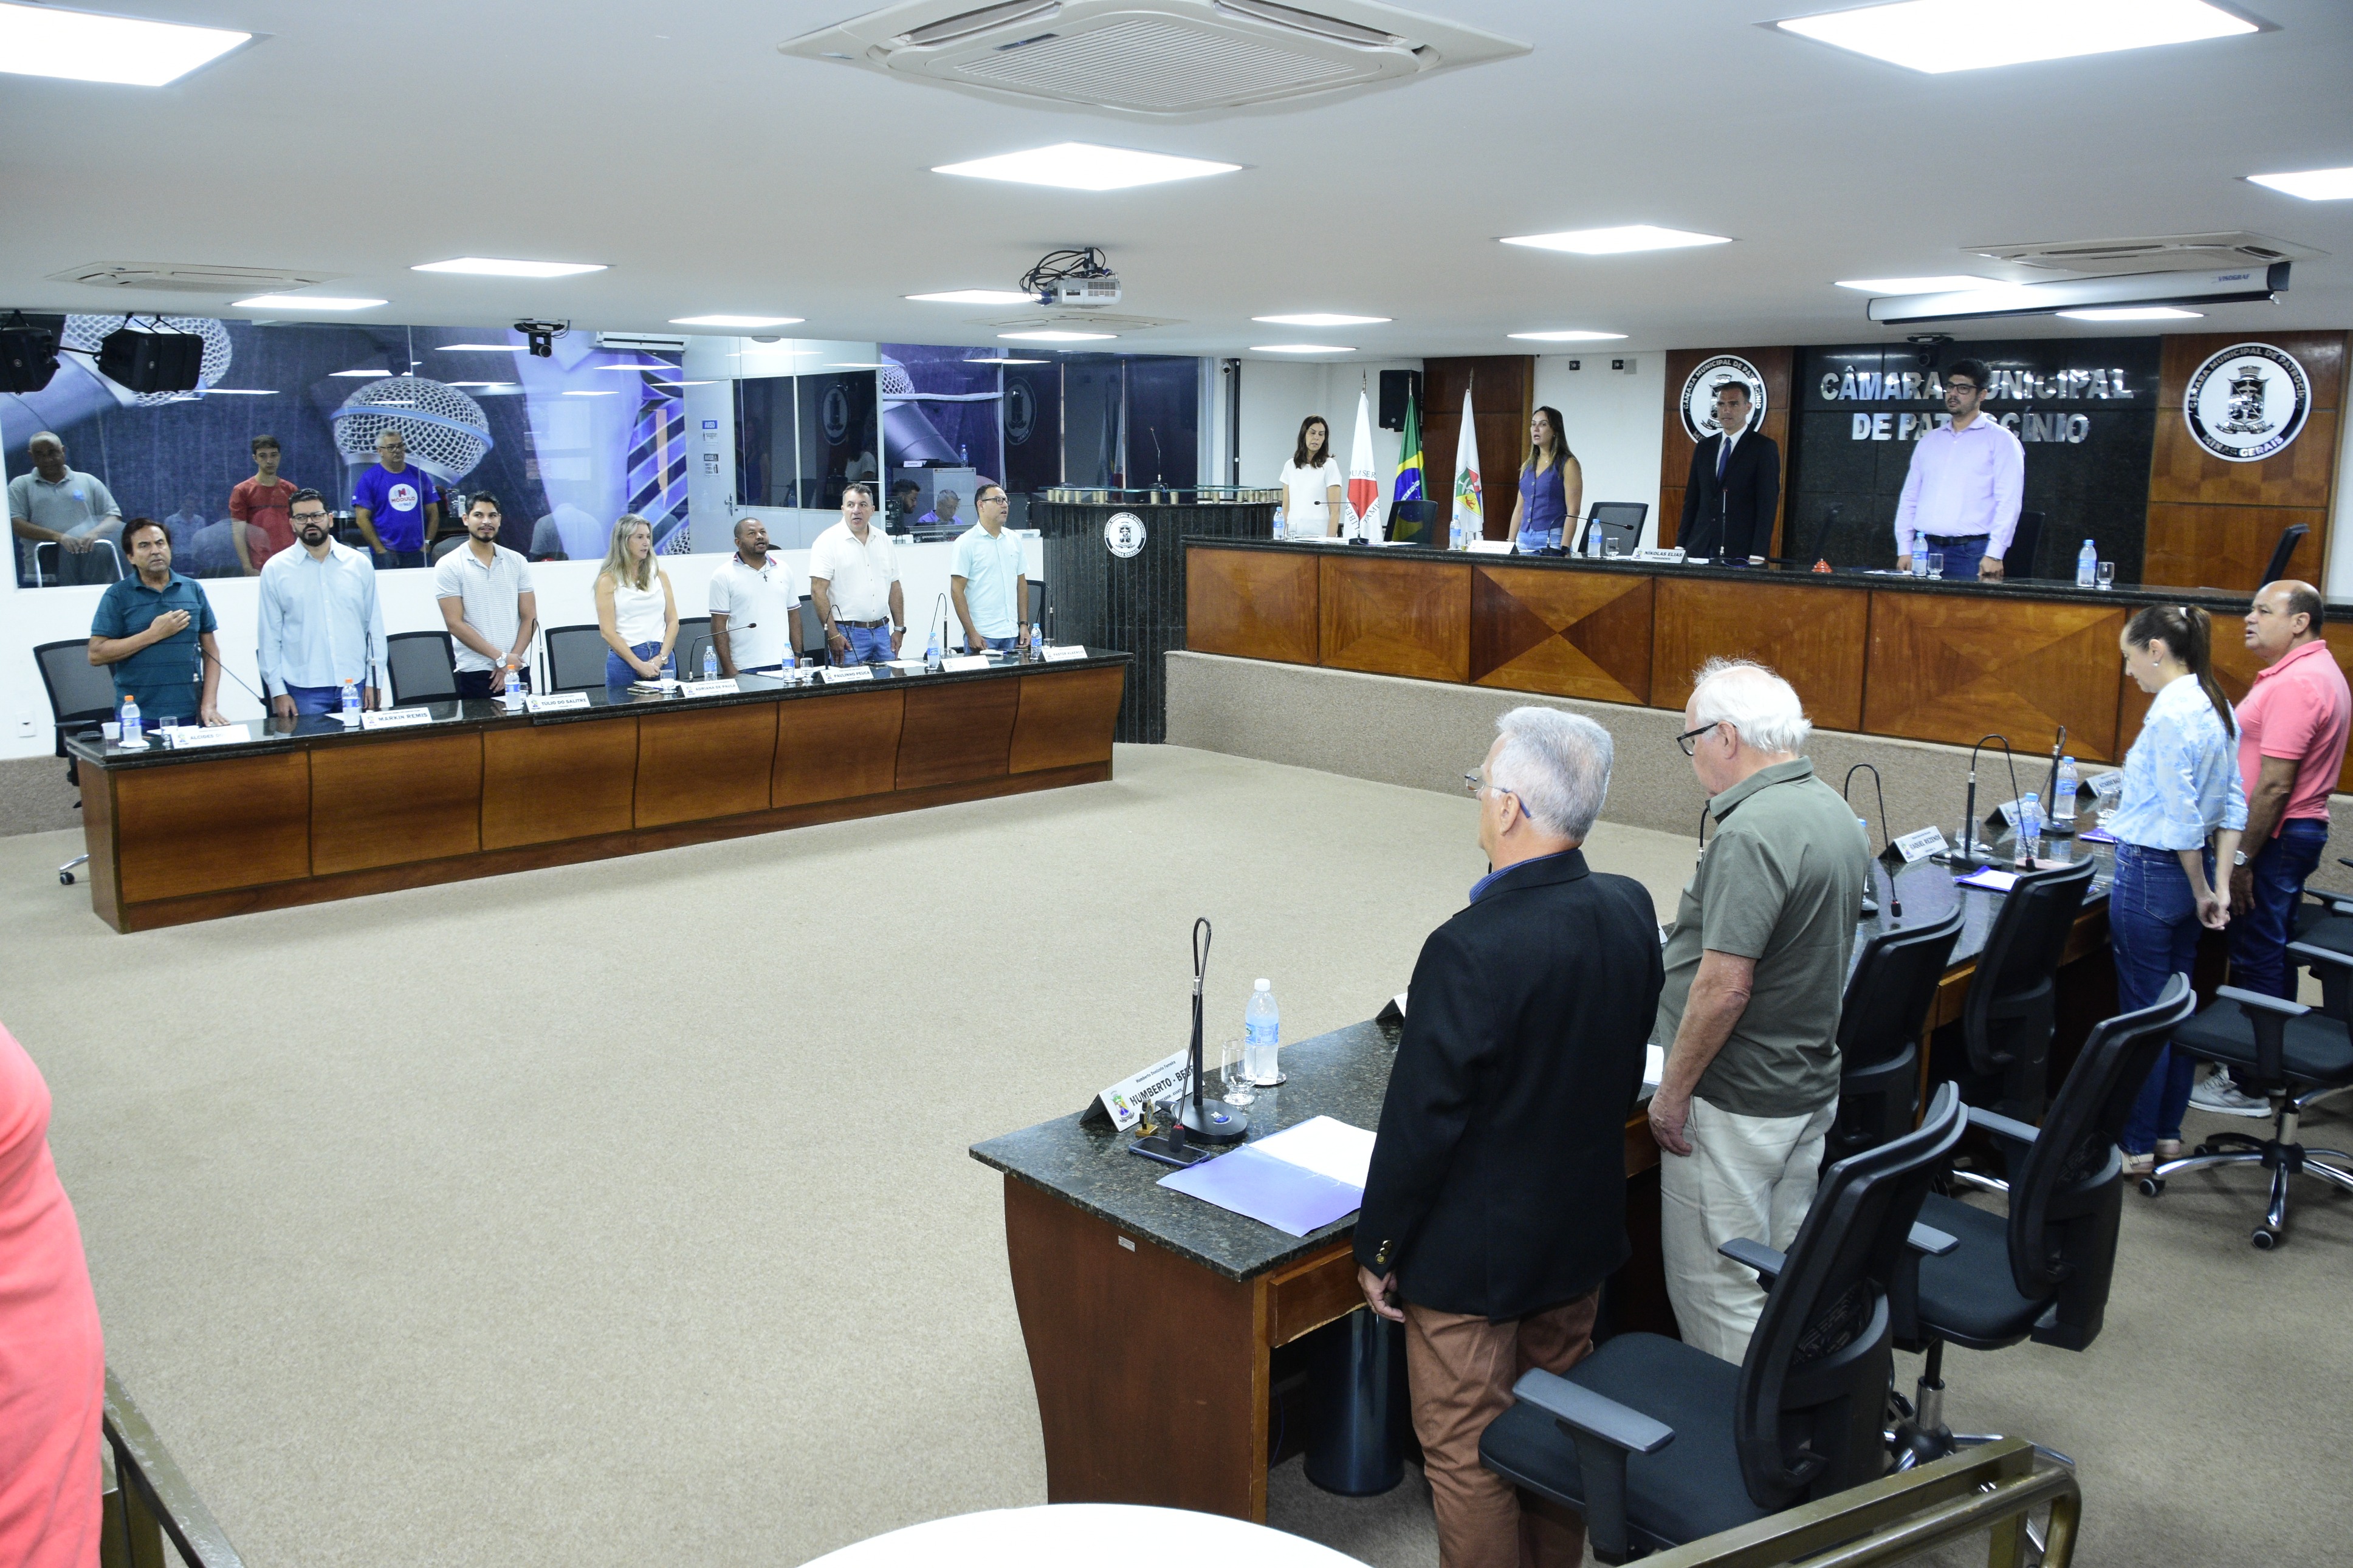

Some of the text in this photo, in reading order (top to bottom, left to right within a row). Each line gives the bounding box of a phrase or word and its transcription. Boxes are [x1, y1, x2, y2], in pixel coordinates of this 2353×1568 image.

[1695, 359, 1732, 378] MUNICIPAL
[1733, 361, 1743, 370] DE
[2210, 347, 2262, 370] MUNICIPAL
[2265, 349, 2280, 360] DE
[2278, 354, 2307, 410] PATROCÍNIO
[1821, 365, 2135, 400] CÂMARA UNICIPAL
[1852, 405, 2090, 443] DE PATCÍNIO
[2202, 433, 2284, 457] MINAS GERAIS
[1136, 1073, 1152, 1083] Humberto
[1164, 1060, 1176, 1069] Ferreira
[1129, 1077, 1173, 1106] HUMBERTO
[1172, 1087, 1183, 1096] AVANTE
